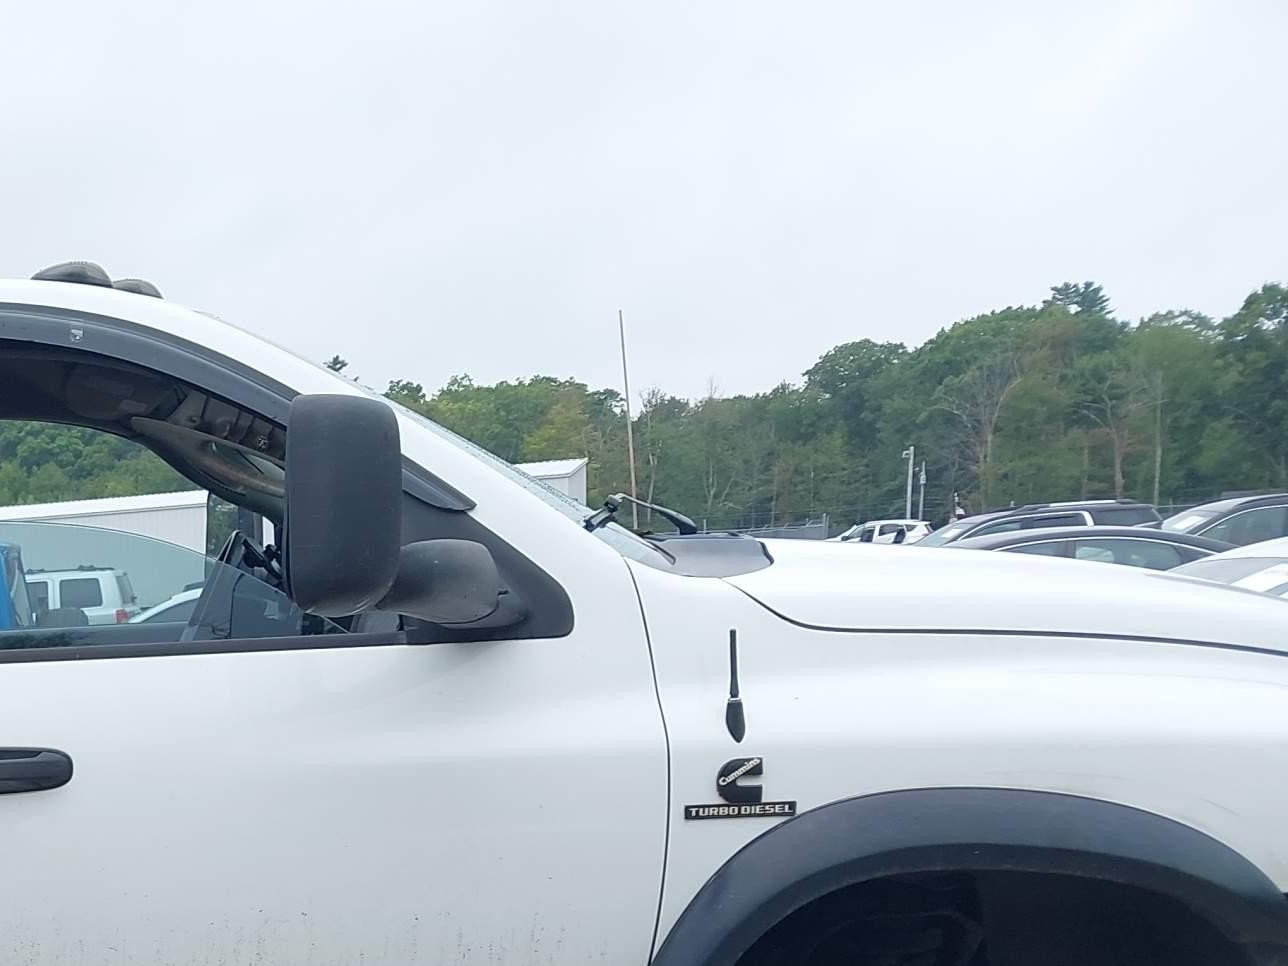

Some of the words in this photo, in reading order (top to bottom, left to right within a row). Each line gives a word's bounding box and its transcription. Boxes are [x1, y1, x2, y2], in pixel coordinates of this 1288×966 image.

[718, 758, 761, 786] Cummins
[688, 806, 739, 817] TURBO
[740, 804, 794, 815] DIESEL
